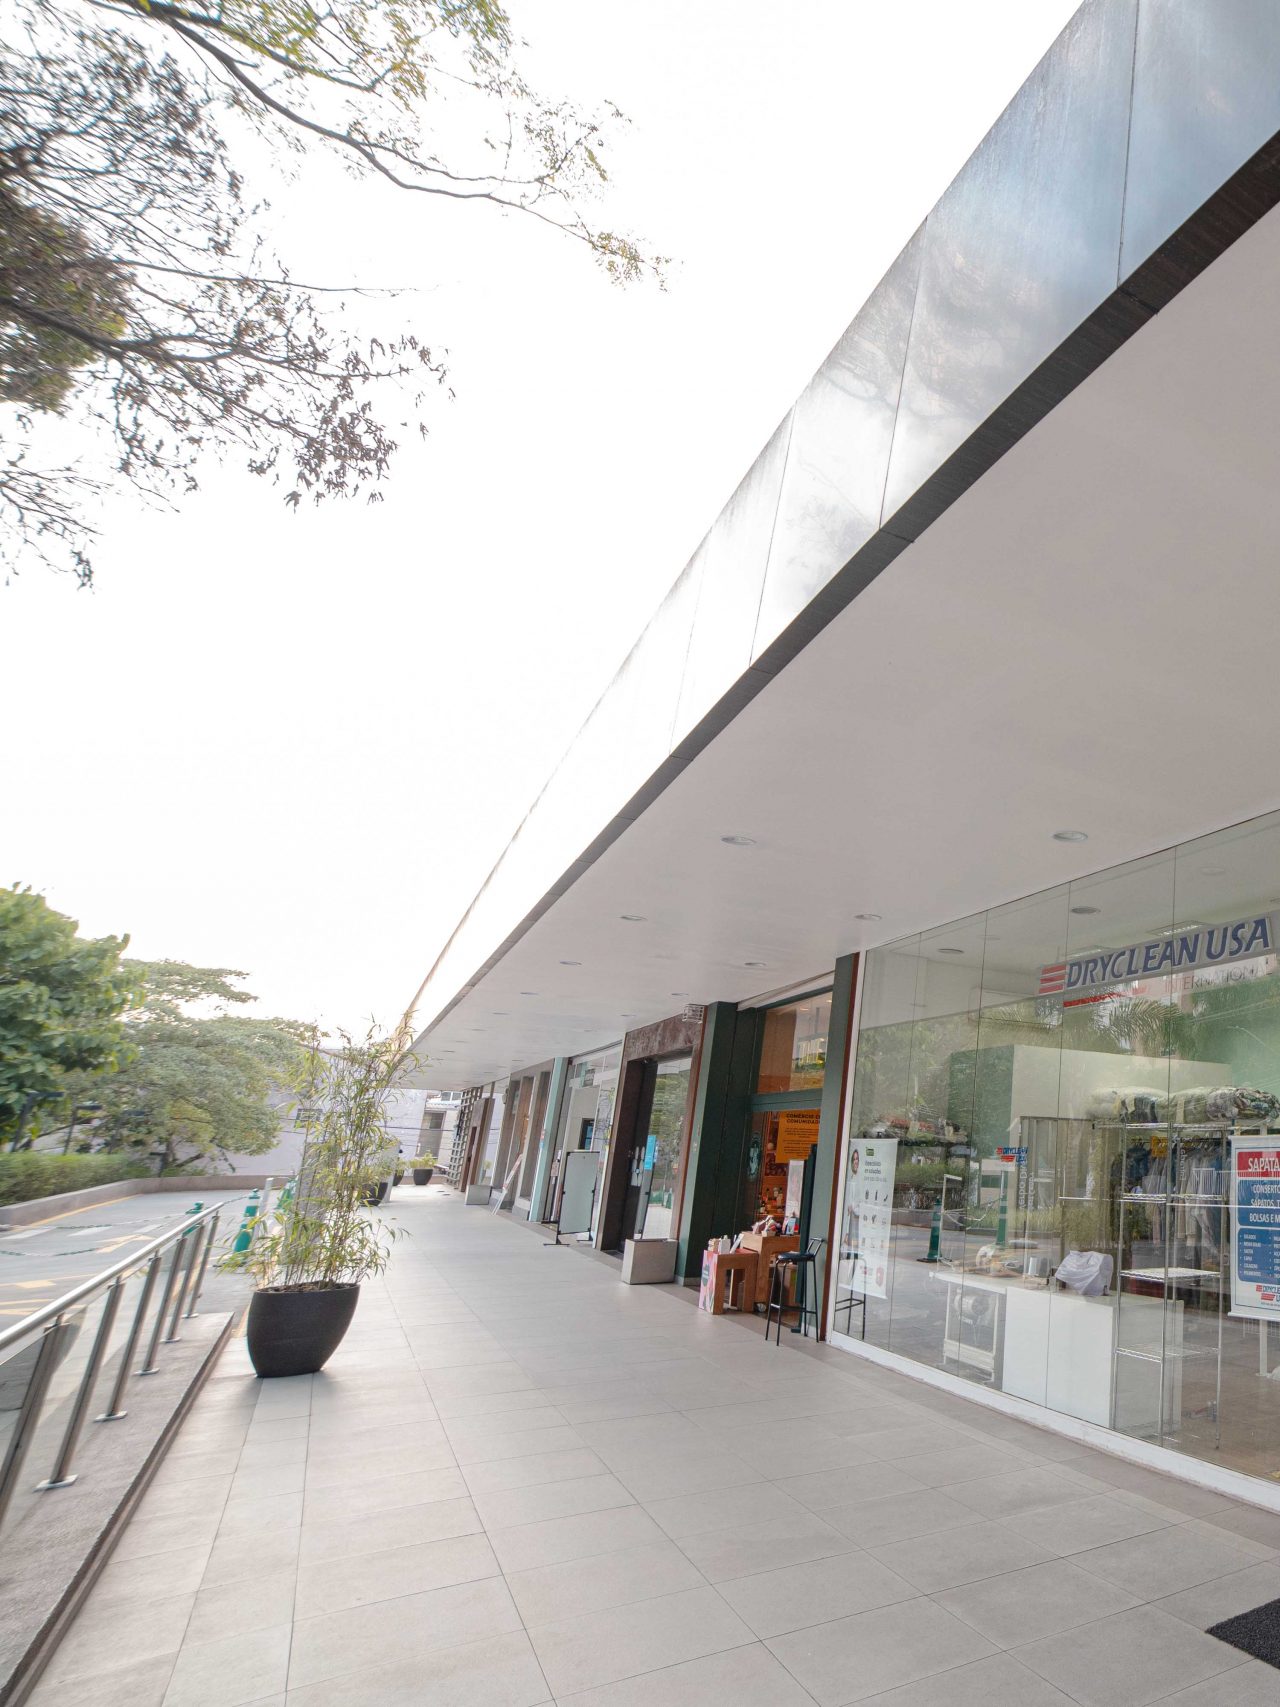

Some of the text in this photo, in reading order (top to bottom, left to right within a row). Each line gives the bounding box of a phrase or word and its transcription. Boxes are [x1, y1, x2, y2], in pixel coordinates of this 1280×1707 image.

[1067, 918, 1271, 988] DRYCLEAN USA
[1249, 1213, 1270, 1223] BOLSAS
